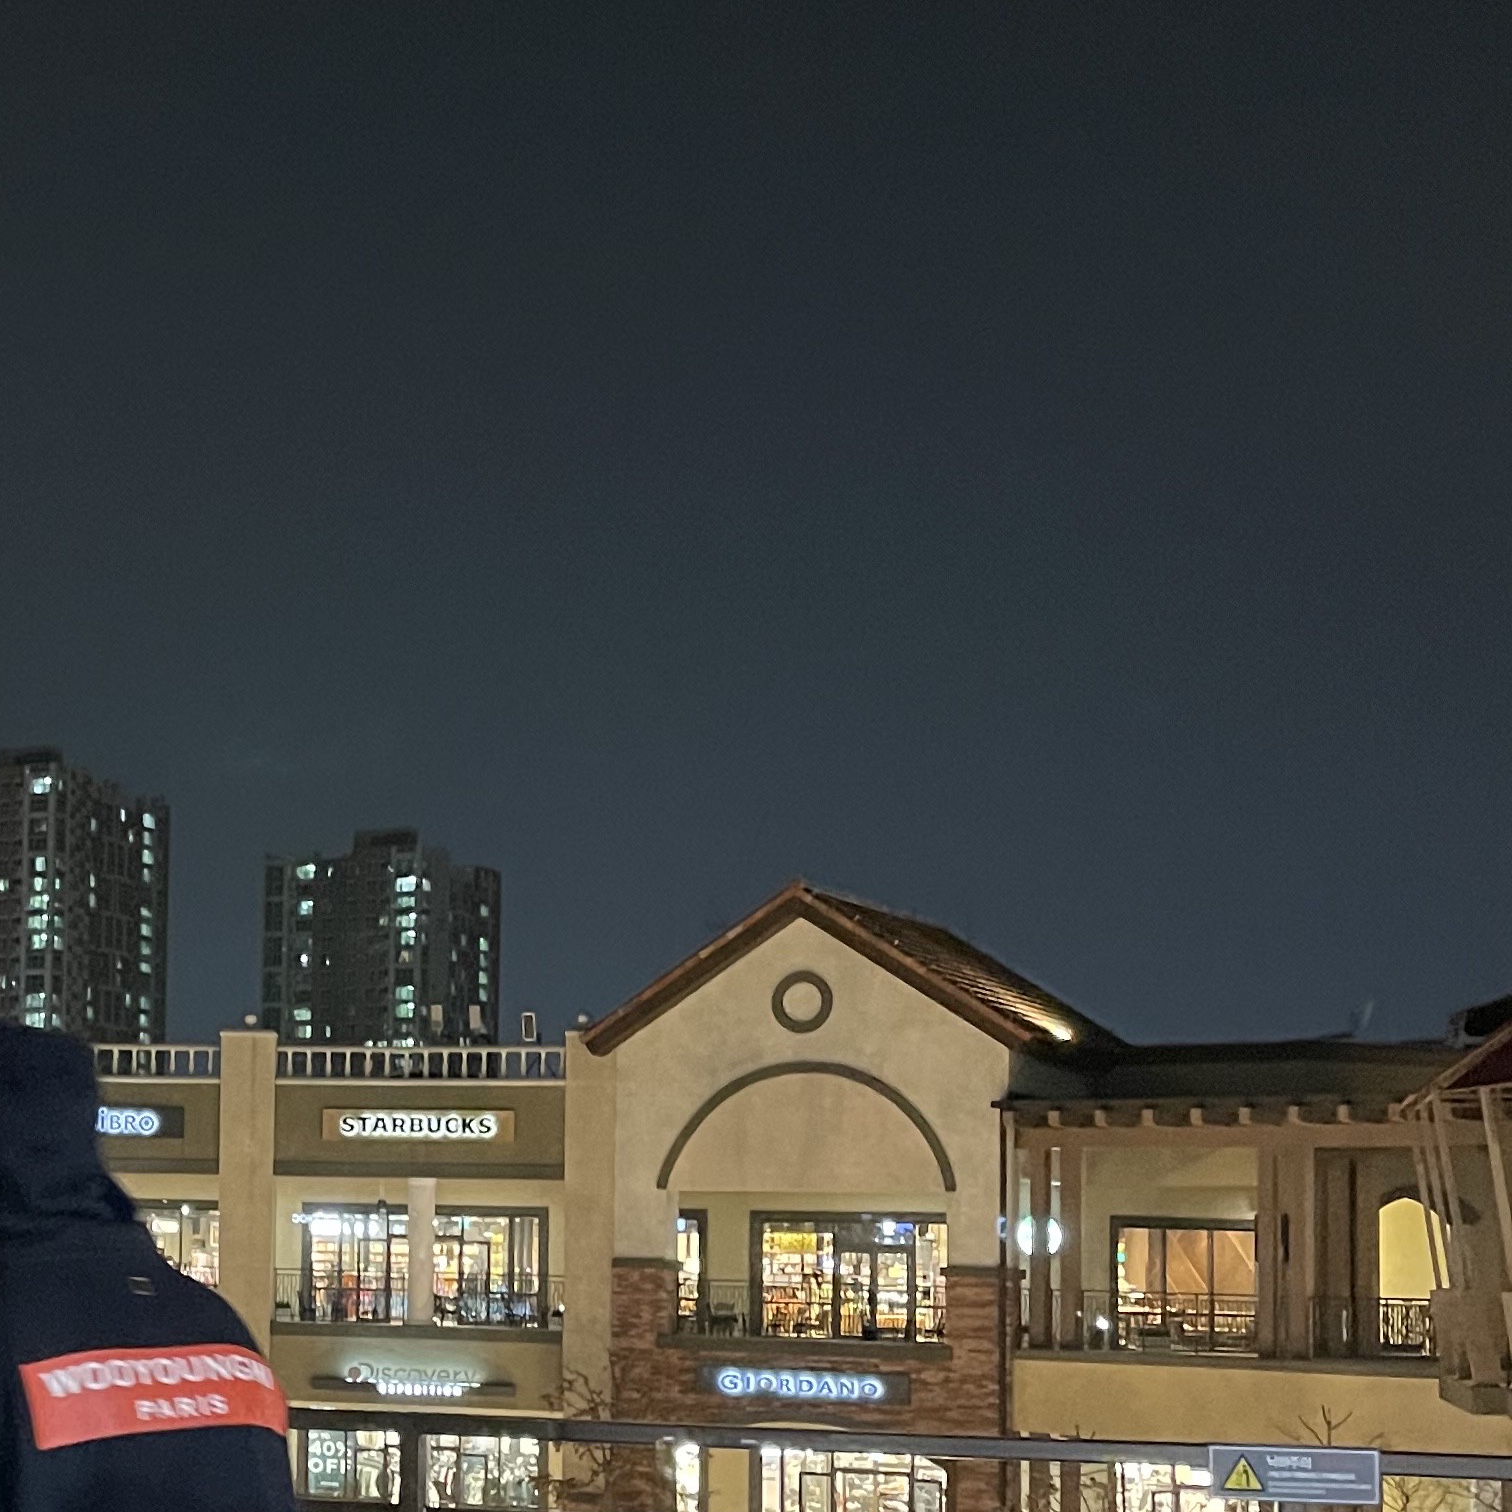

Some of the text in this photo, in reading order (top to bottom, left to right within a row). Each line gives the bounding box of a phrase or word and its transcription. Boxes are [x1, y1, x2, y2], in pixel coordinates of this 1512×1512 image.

[97, 1108, 157, 1133] iBRO
[340, 1115, 493, 1135] STARBUCKS
[348, 1362, 478, 1383] Discovery
[719, 1372, 880, 1399] GIORDANO
[134, 1393, 230, 1421] PARIS
[308, 1457, 352, 1475] OFF
